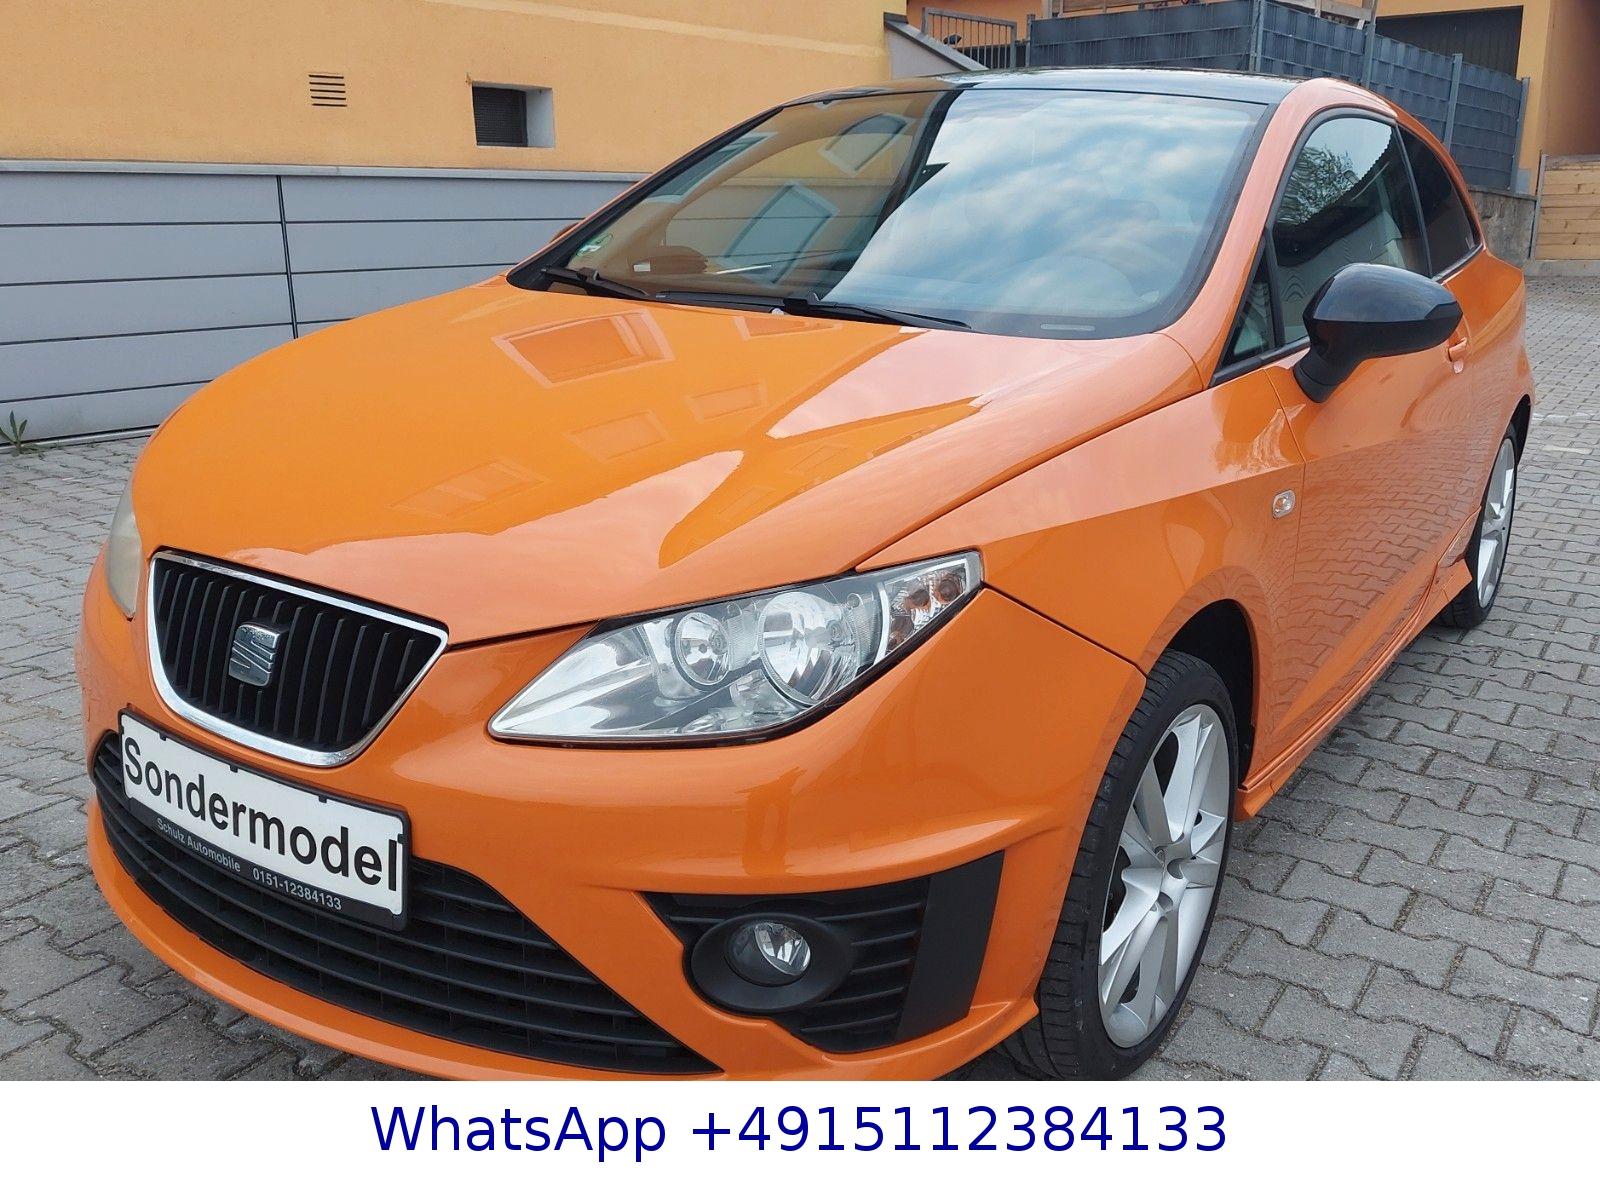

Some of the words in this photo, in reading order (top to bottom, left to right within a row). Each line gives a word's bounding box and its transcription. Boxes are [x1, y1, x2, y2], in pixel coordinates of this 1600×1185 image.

[124, 736, 397, 892] Sondermodel
[157, 817, 185, 844] Schulz
[187, 835, 241, 872] Automobile
[252, 867, 342, 910] 0151-12384133
